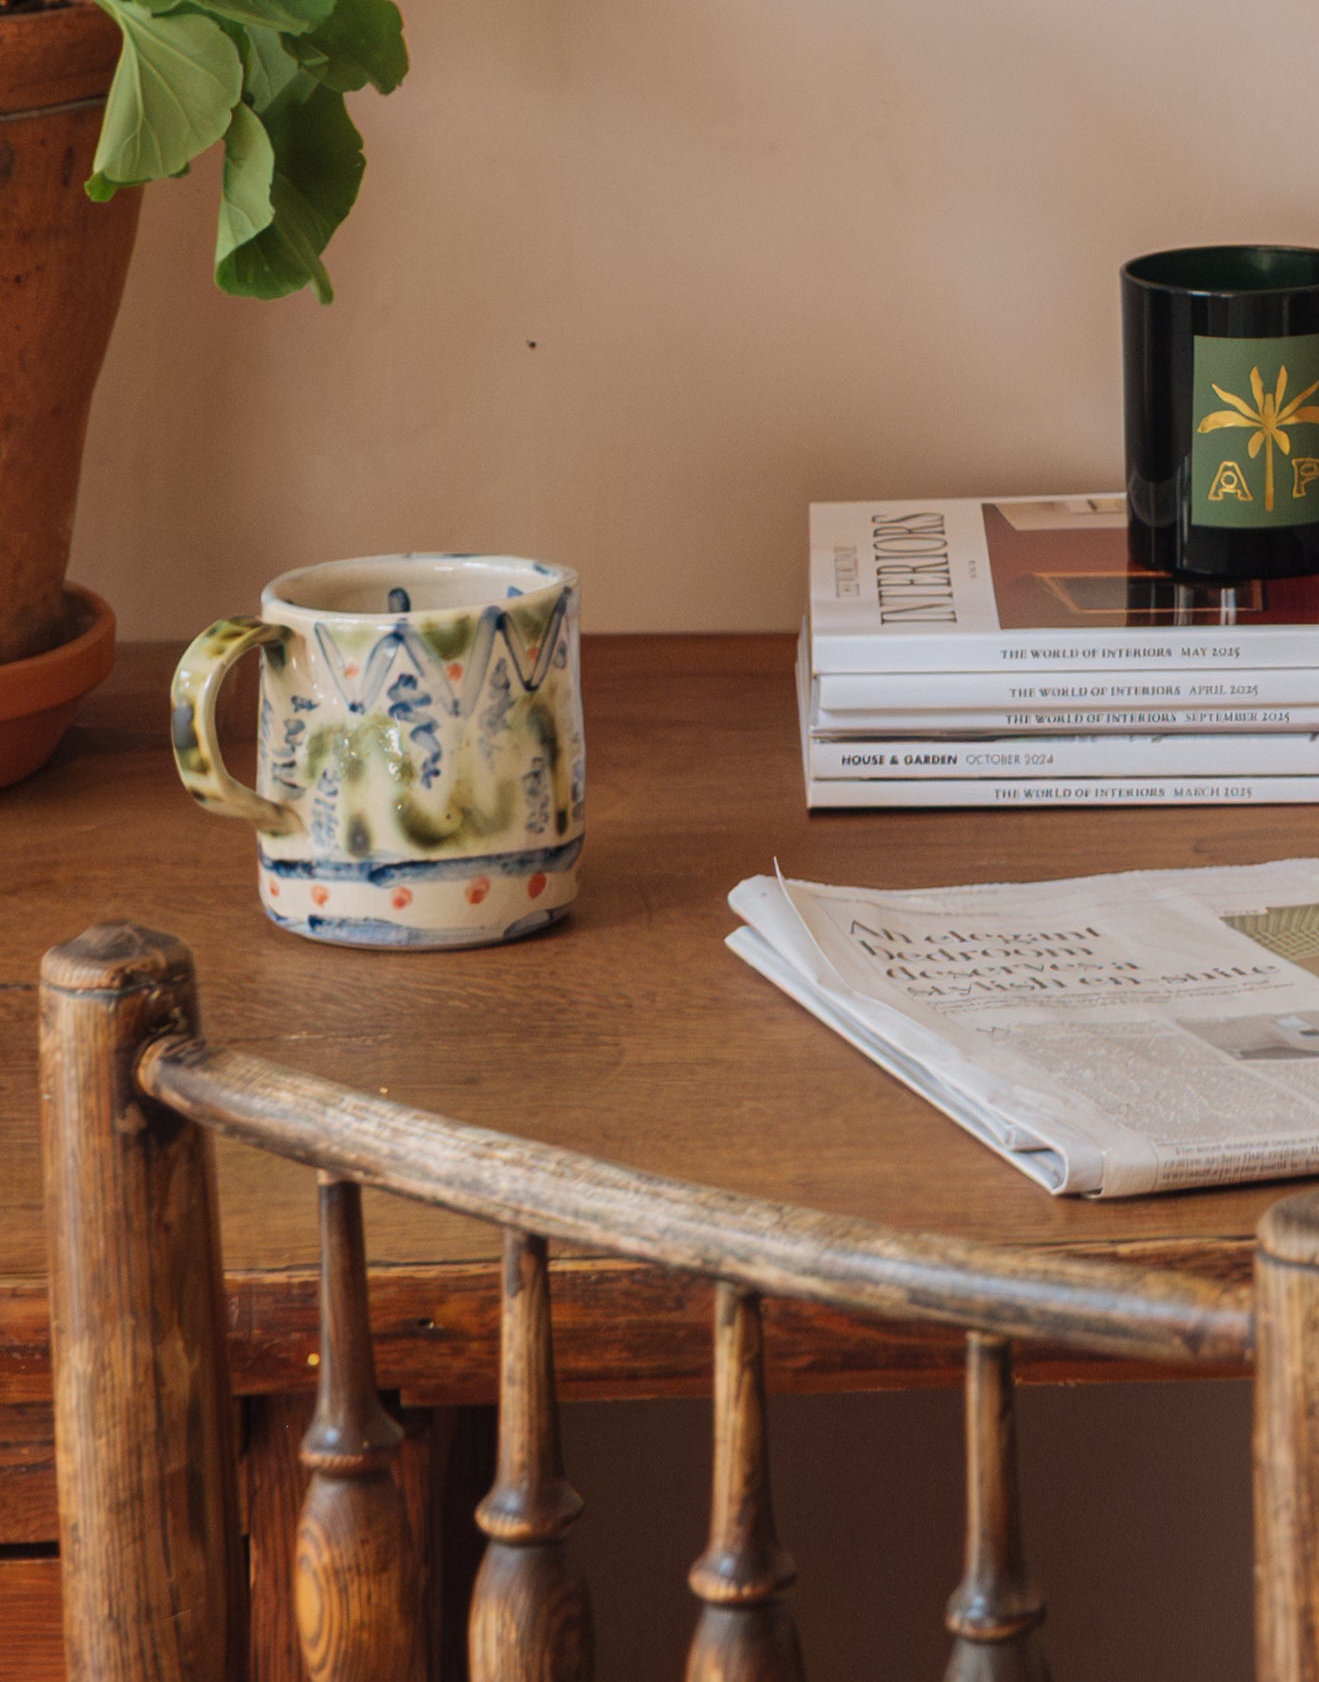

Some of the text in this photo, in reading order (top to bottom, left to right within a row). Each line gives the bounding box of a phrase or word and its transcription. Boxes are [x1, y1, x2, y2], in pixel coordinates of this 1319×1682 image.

[1207, 460, 1254, 503] A
[870, 512, 958, 626] INTERIORS
[1000, 646, 1240, 659] THE WORLD OF INTERIORS MAY 2025
[1009, 684, 1258, 698] THE WORLD OF INTERIORS APRIL 2025
[1005, 711, 1290, 724] THE WORLD OF INTERIORS SEPTEMBER 2025
[841, 753, 1054, 766] HOUSE & GARDEN OCTOBER 2024
[994, 788, 1020, 799] THE
[1023, 788, 1072, 799] WORLD
[1074, 787, 1091, 798] OF
[1095, 787, 1166, 798] INTERIORS
[1173, 787, 1220, 798] MARCH
[924, 927, 1100, 945] elegant
[859, 939, 1094, 962] bedroom
[885, 962, 1104, 982] deserves
[906, 975, 1067, 996] stylish
